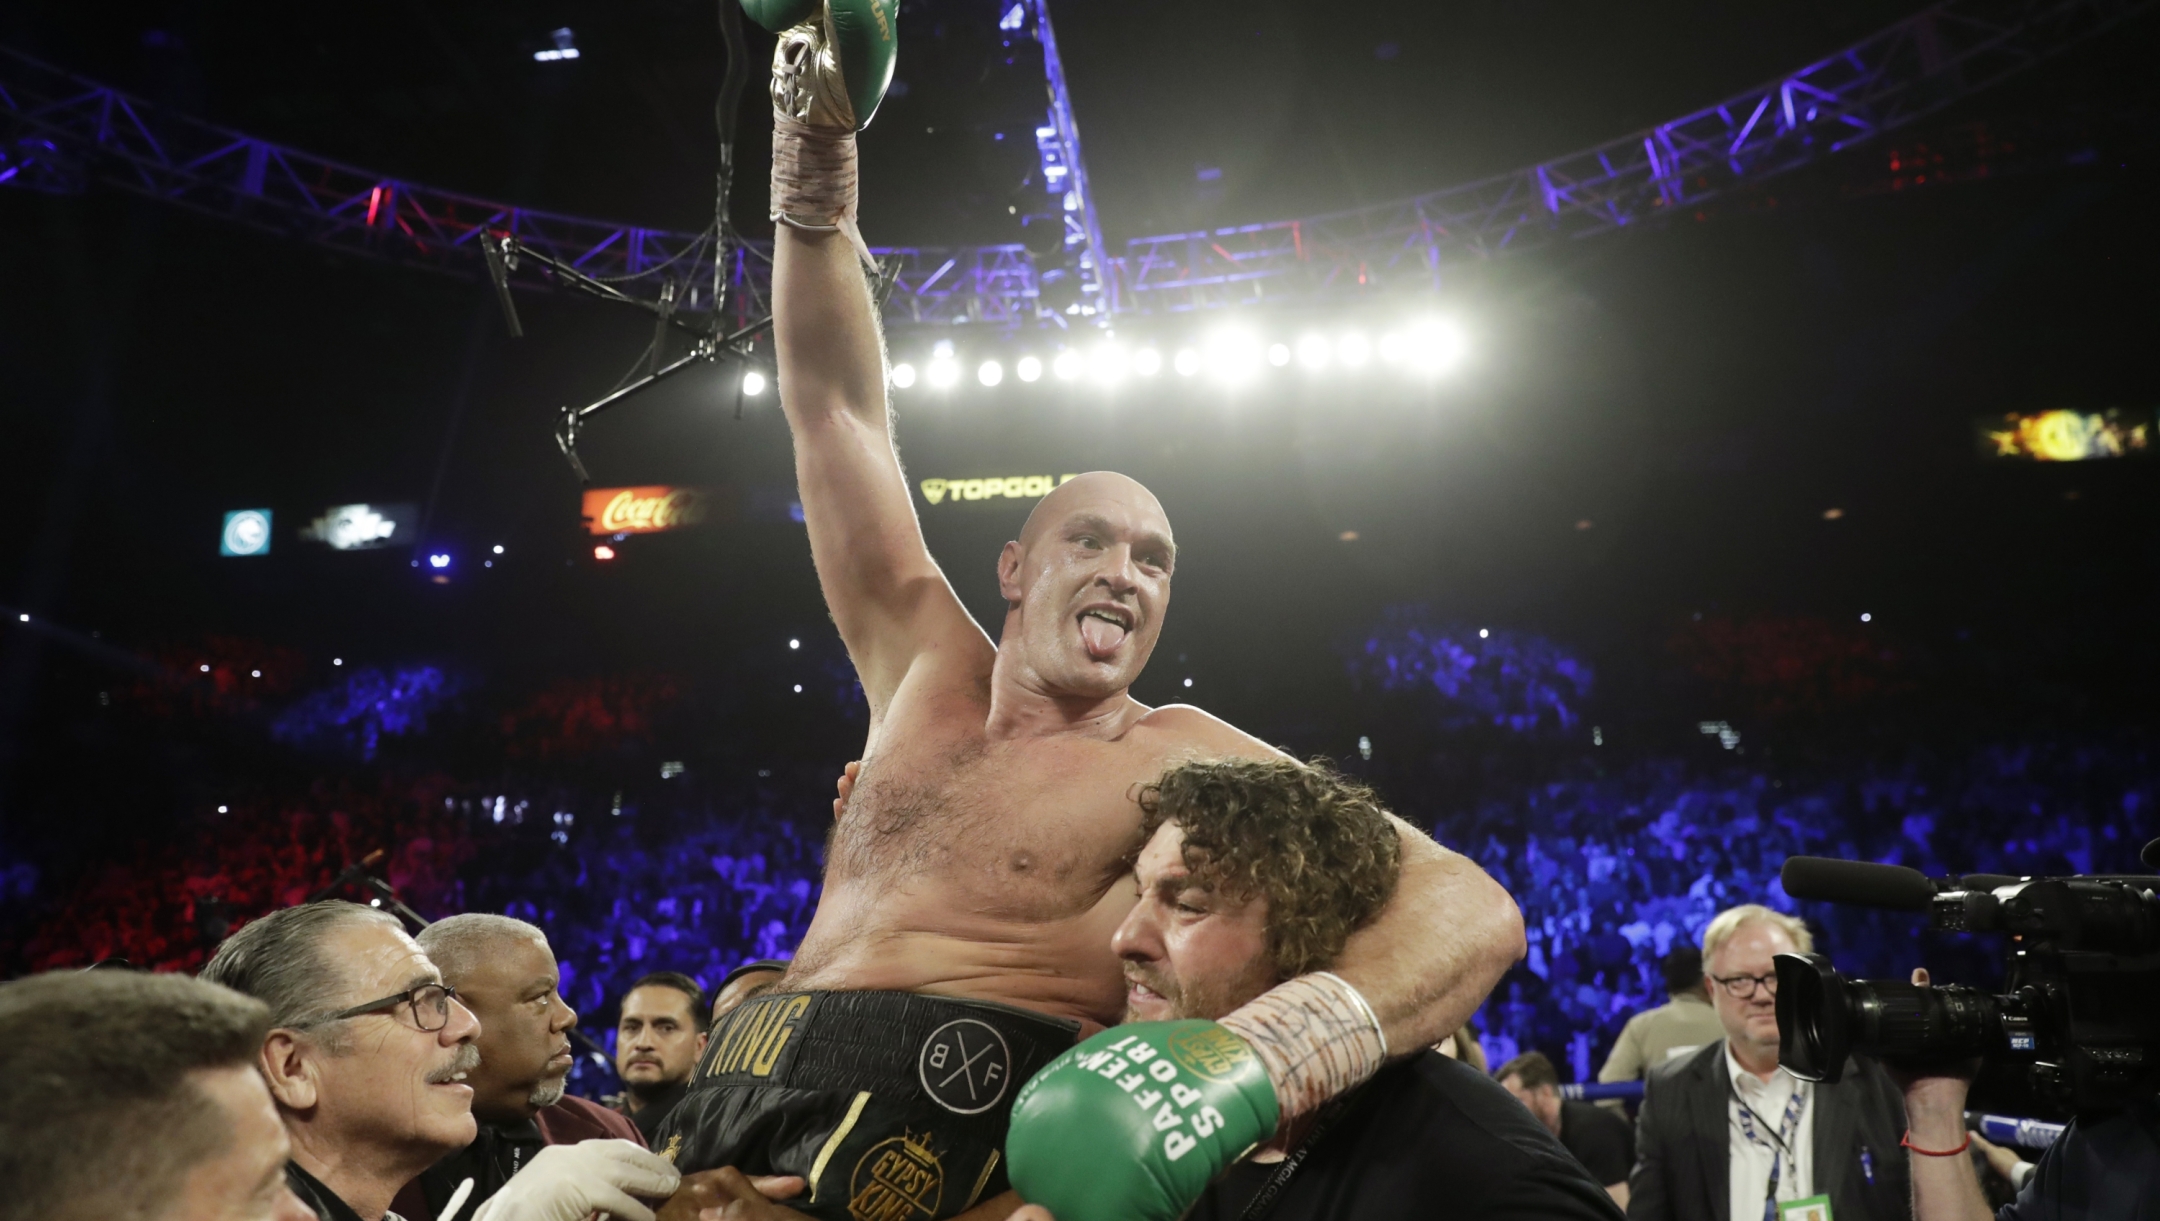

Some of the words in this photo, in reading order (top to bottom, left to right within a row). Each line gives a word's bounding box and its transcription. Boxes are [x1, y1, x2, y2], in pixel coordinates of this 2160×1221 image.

[869, 0, 891, 41] URY
[706, 995, 811, 1077] KING
[1274, 1158, 1299, 1187] MGM
[1294, 1145, 1309, 1163] AT
[871, 1149, 939, 1202] GYPSY
